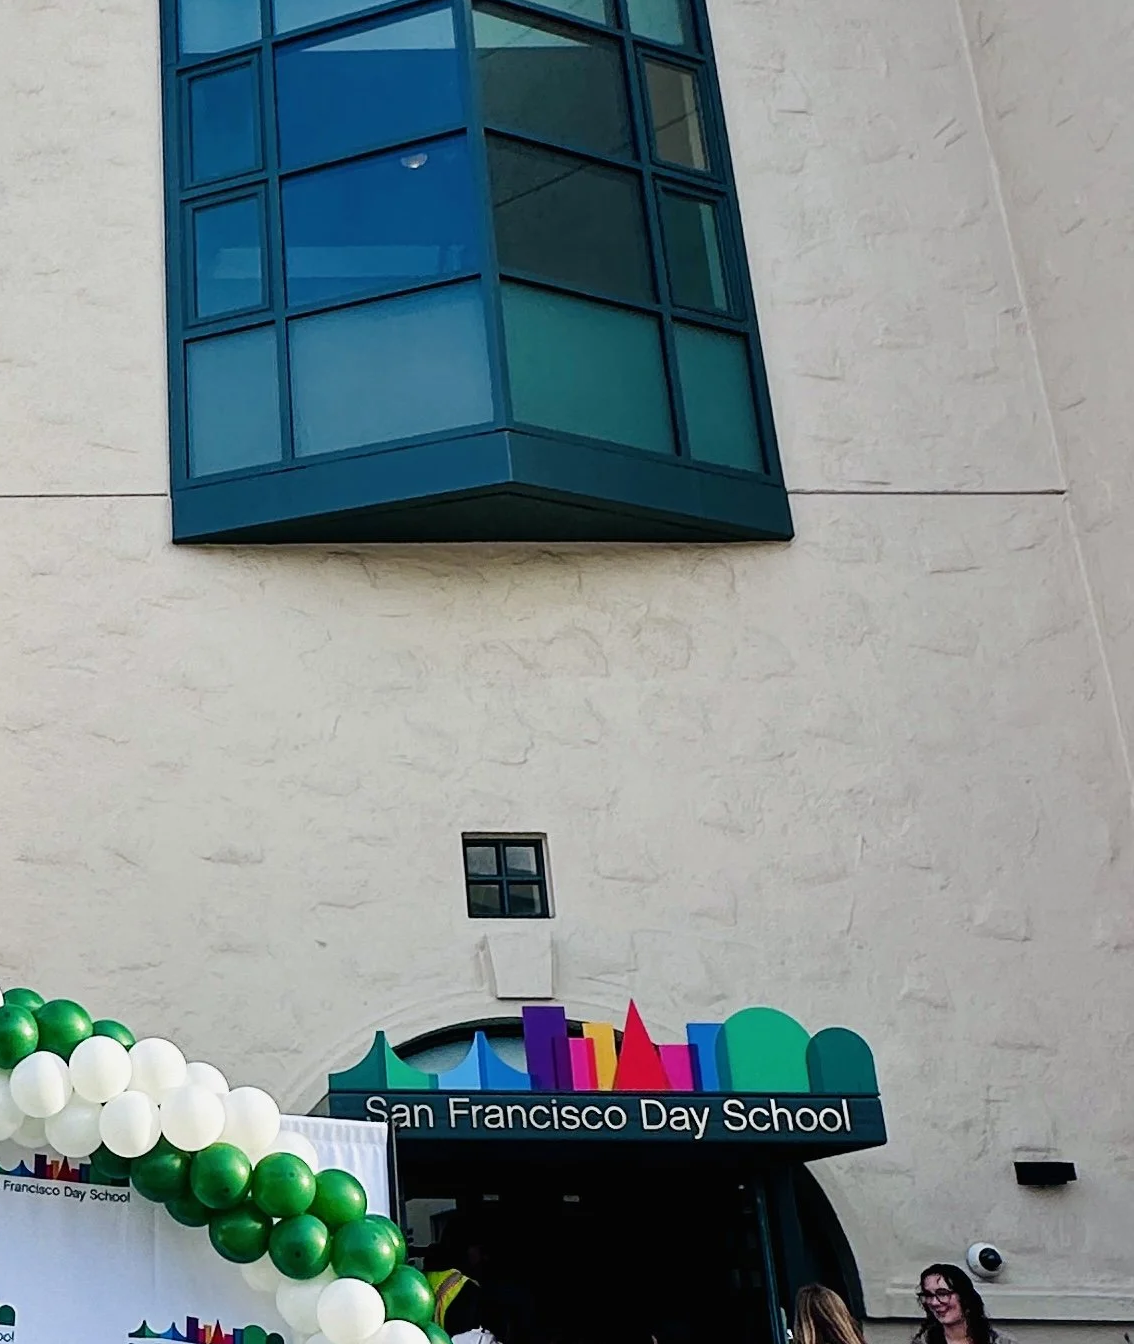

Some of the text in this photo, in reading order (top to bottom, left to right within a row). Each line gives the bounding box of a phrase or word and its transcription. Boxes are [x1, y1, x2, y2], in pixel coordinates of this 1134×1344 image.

[366, 1096, 852, 1140] San Francisco Day School
[3, 1179, 60, 1196] Francisco
[64, 1186, 86, 1203] Day
[89, 1188, 131, 1203] School
